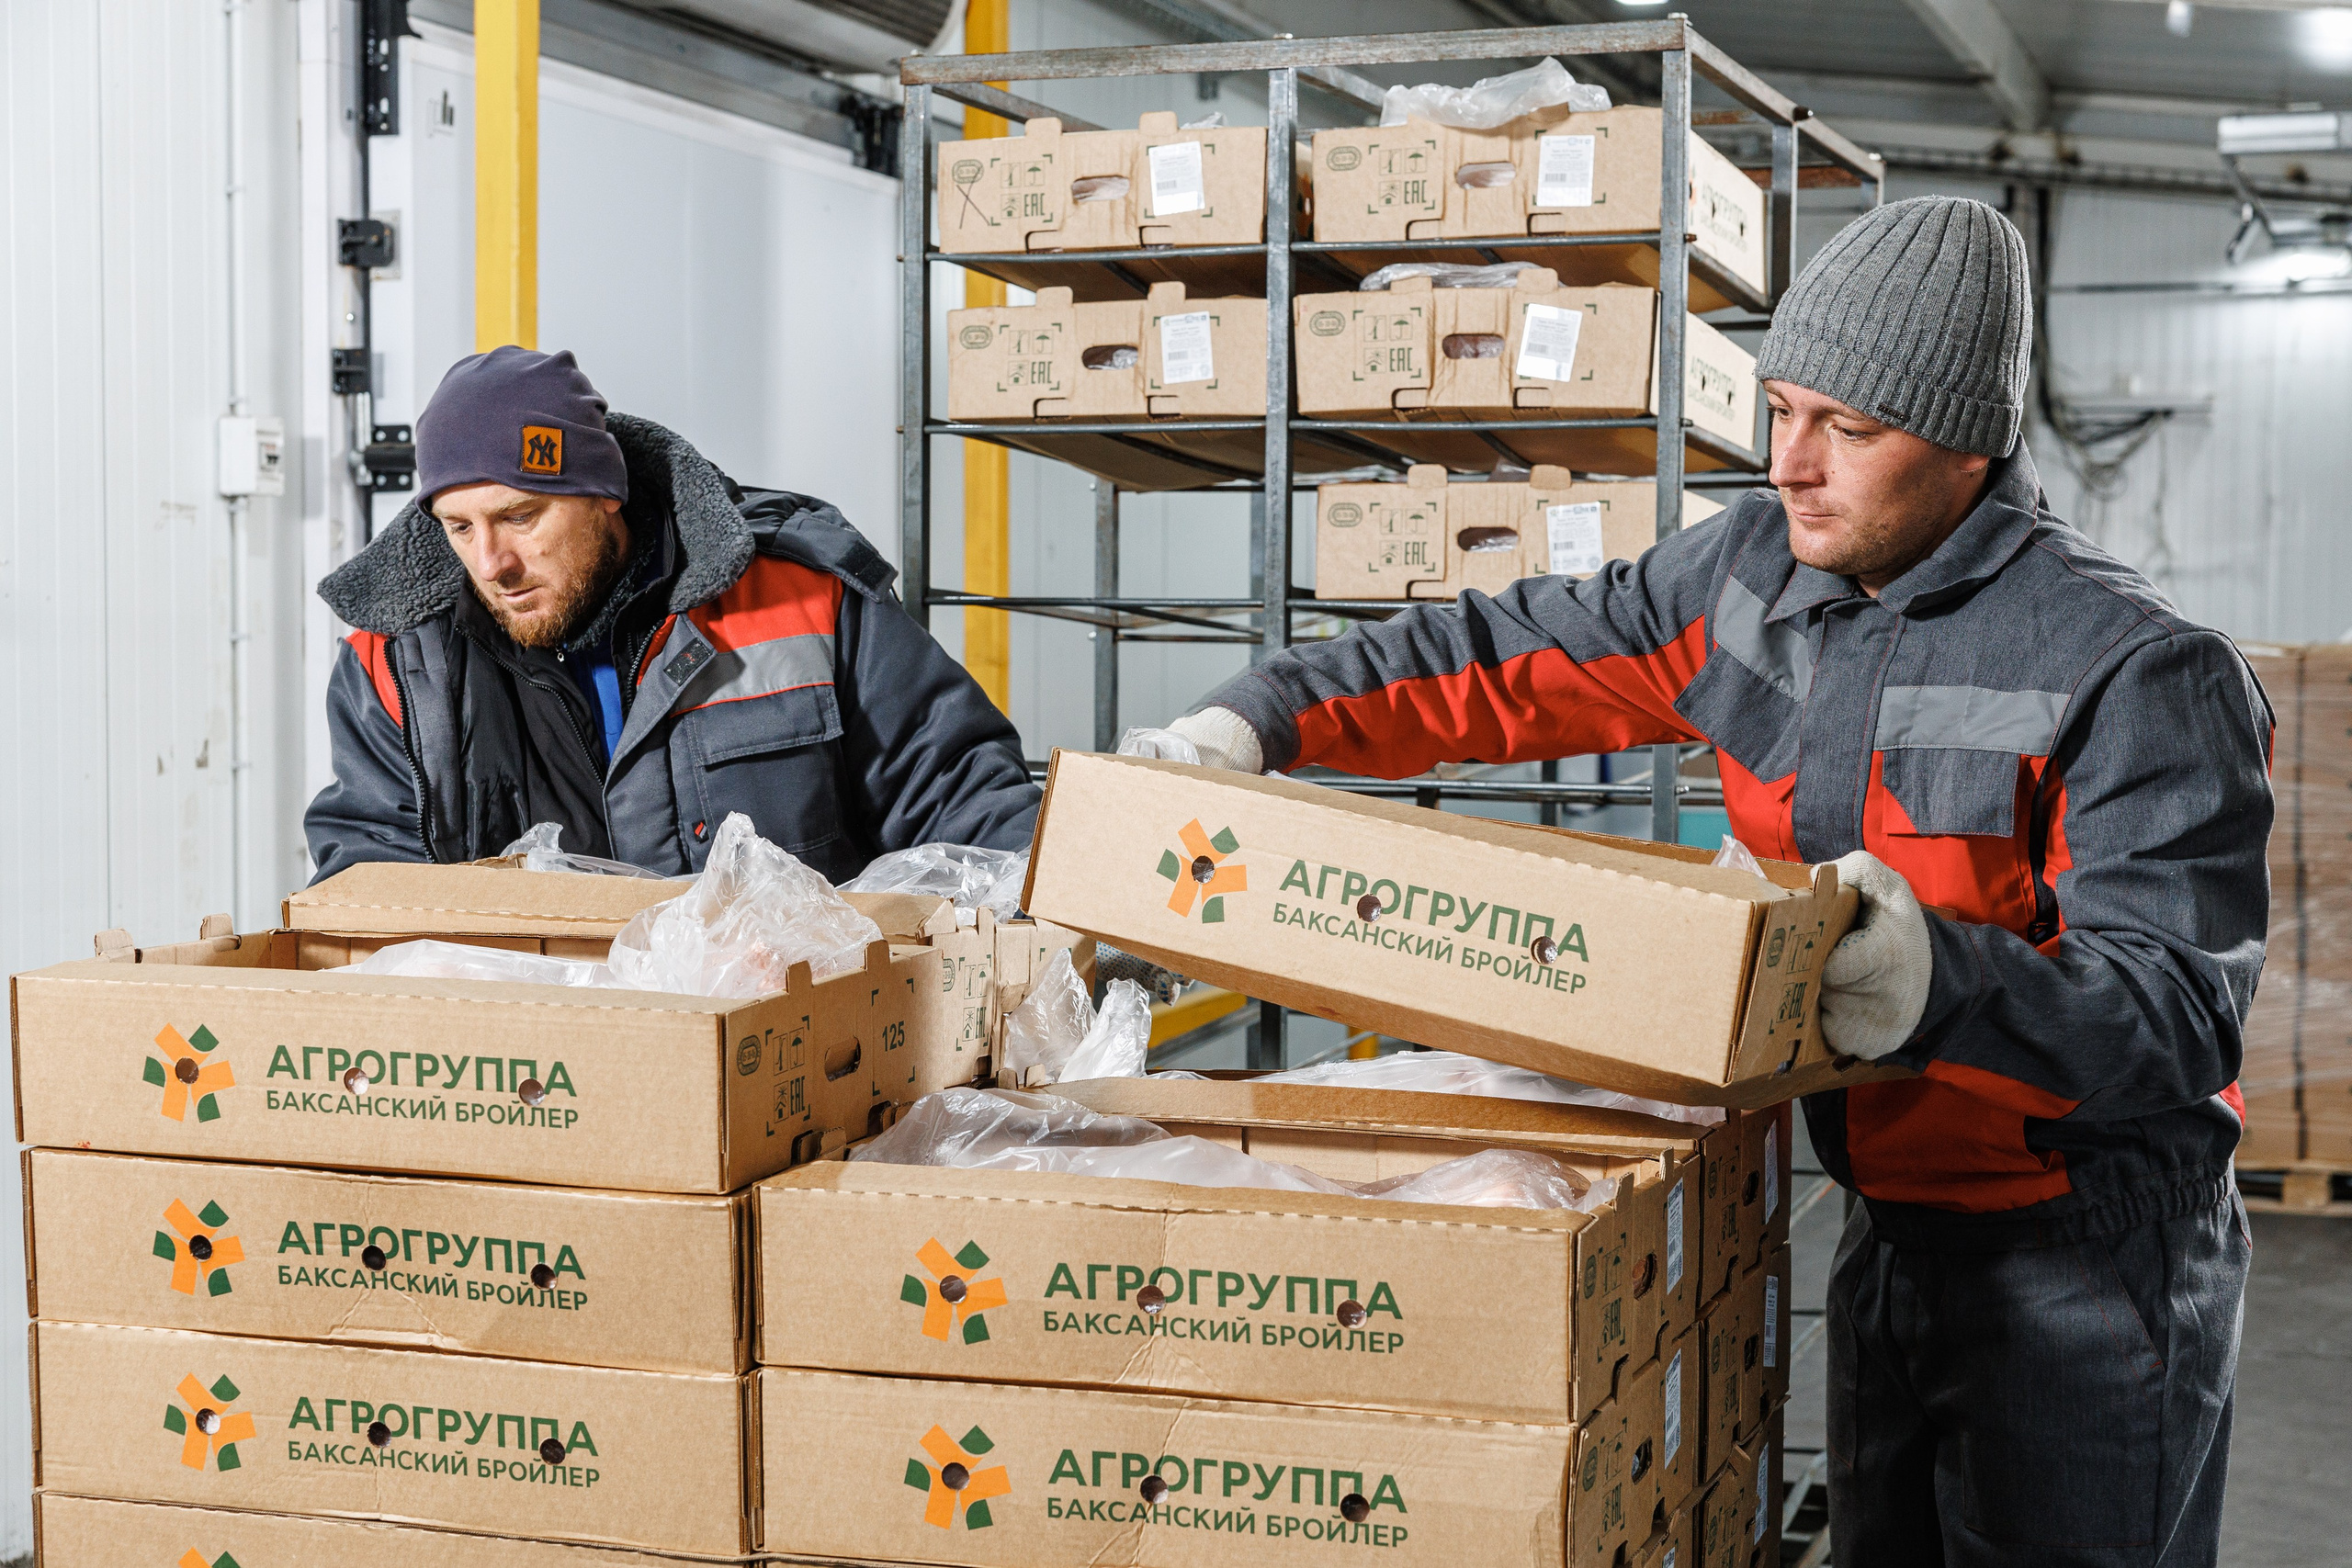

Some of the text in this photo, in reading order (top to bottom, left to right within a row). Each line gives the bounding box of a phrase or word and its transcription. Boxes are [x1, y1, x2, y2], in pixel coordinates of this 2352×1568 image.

[526, 434, 557, 468] NY
[1279, 859, 1589, 963] АГРОГРУППА
[1272, 902, 1587, 994] БАКСАНСКИЙ БРОЙЛЕР
[881, 1021, 905, 1051] 125
[266, 1044, 577, 1097] АГРОГРУППА
[266, 1089, 579, 1130] БАКСАНСКИЙ БРОЙЛЕР
[278, 1221, 585, 1280] АГРОГРУППА
[277, 1265, 588, 1311] БАКСАНСКИЙ БРОЙЛЕР
[1045, 1262, 1402, 1320] АГРОГРУППА
[1044, 1311, 1404, 1353] БАКСАНСКИЙ БРОЙЛЕР
[288, 1396, 599, 1457] АГРОГРУППА
[288, 1441, 600, 1488] БАКСАНСКИЙ БРОЙЛЕР
[1049, 1449, 1408, 1513] АГРОГРУППА
[1047, 1497, 1408, 1548] БАКСАНСКИЙ БРОЙЛЕР
